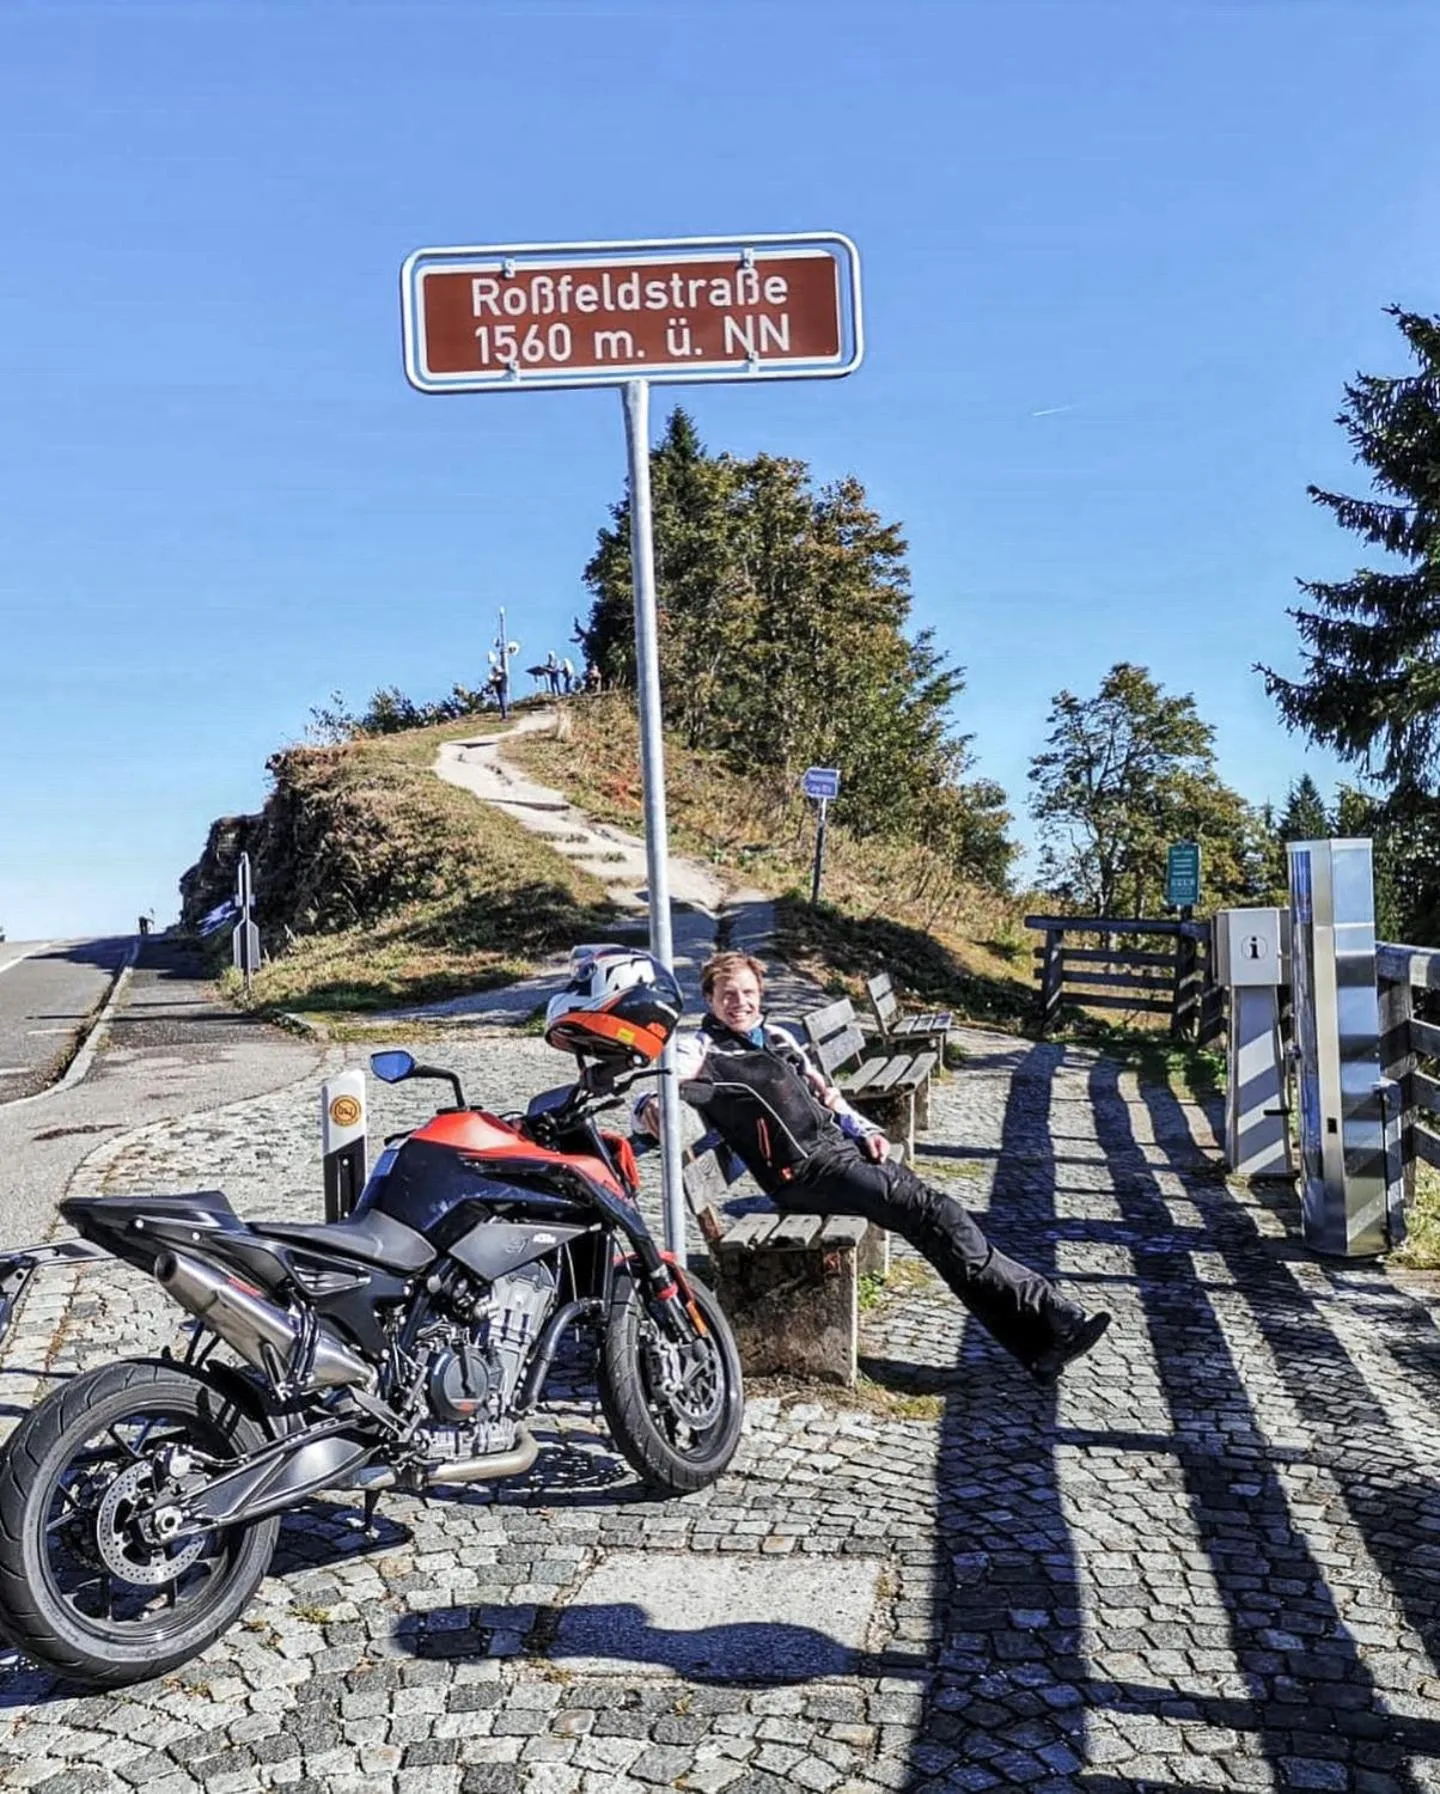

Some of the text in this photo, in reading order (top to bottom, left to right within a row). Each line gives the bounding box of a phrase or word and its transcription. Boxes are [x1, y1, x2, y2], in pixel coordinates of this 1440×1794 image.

[471, 267, 788, 317] Roßfeldstraße
[475, 313, 790, 365] 1560 m. ü. NN
